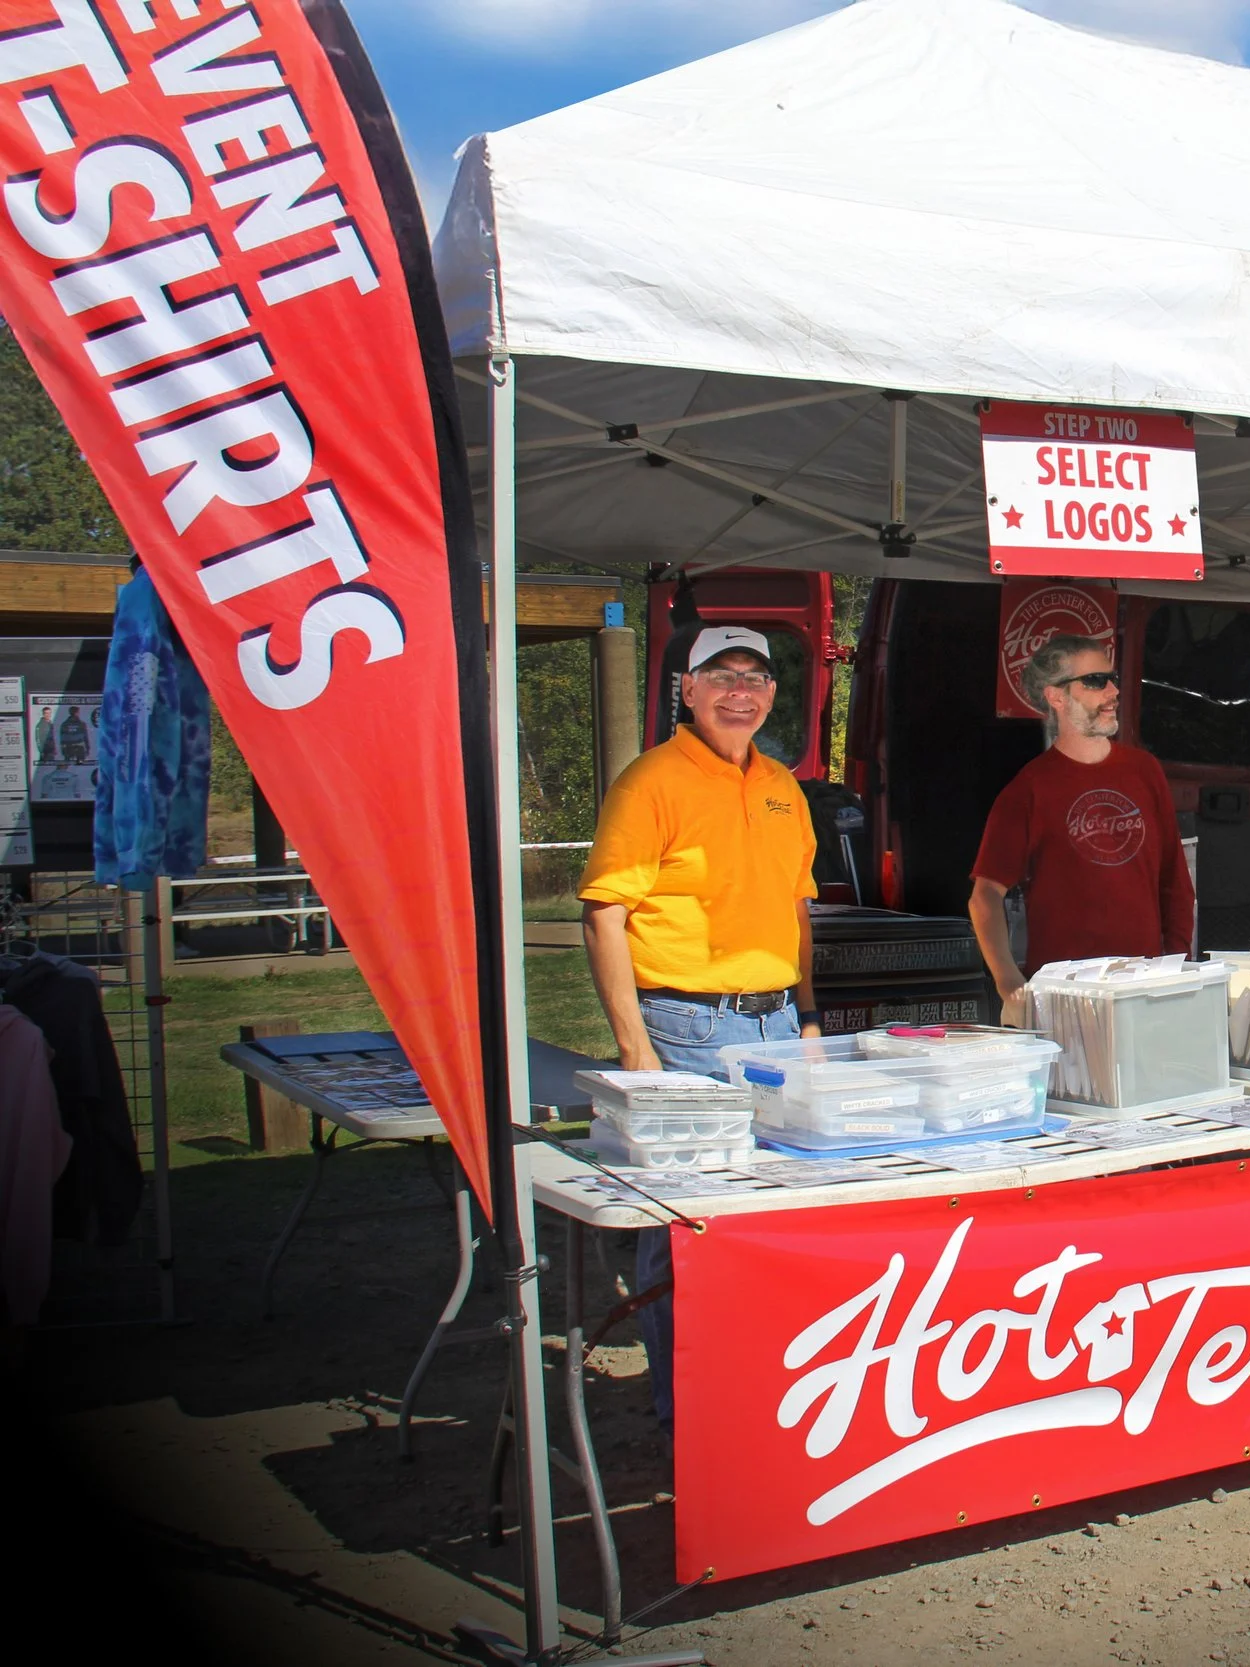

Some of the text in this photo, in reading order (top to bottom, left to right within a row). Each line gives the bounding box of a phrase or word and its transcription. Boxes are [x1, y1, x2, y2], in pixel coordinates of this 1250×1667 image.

[117, 0, 379, 306] VENT
[0, 0, 404, 710] T-SHIRTS
[1044, 412, 1137, 441] STEP TWO
[1036, 446, 1151, 491] SELECT
[1045, 500, 1153, 543] LOGOS
[1020, 592, 1102, 631] THE CENTER FOR
[1069, 808, 1142, 836] Hot Tees
[777, 1215, 1103, 1460] Hot
